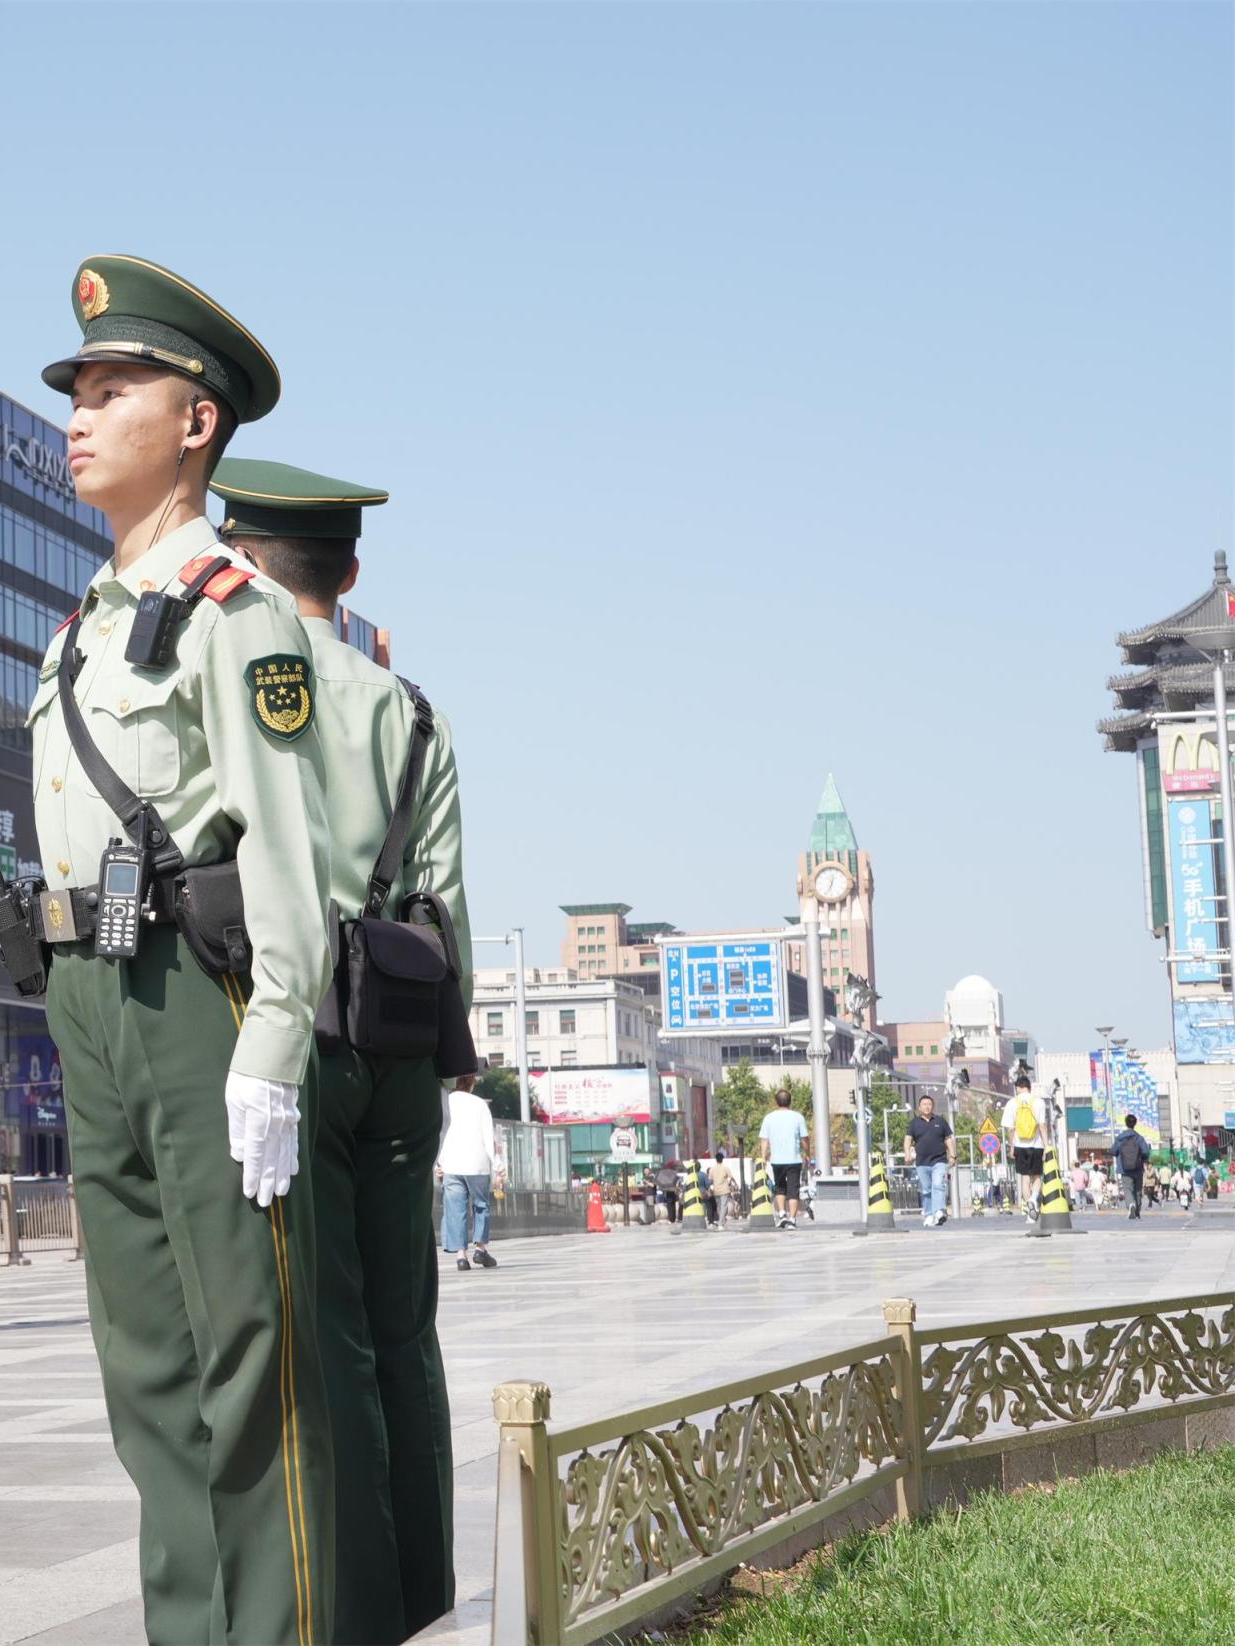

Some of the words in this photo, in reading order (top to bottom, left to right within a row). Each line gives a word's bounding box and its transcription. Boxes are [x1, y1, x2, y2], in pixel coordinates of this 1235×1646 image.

[255, 663, 304, 676] 中国人民
[255, 673, 305, 686] 武装警察部队
[671, 969, 679, 981] P
